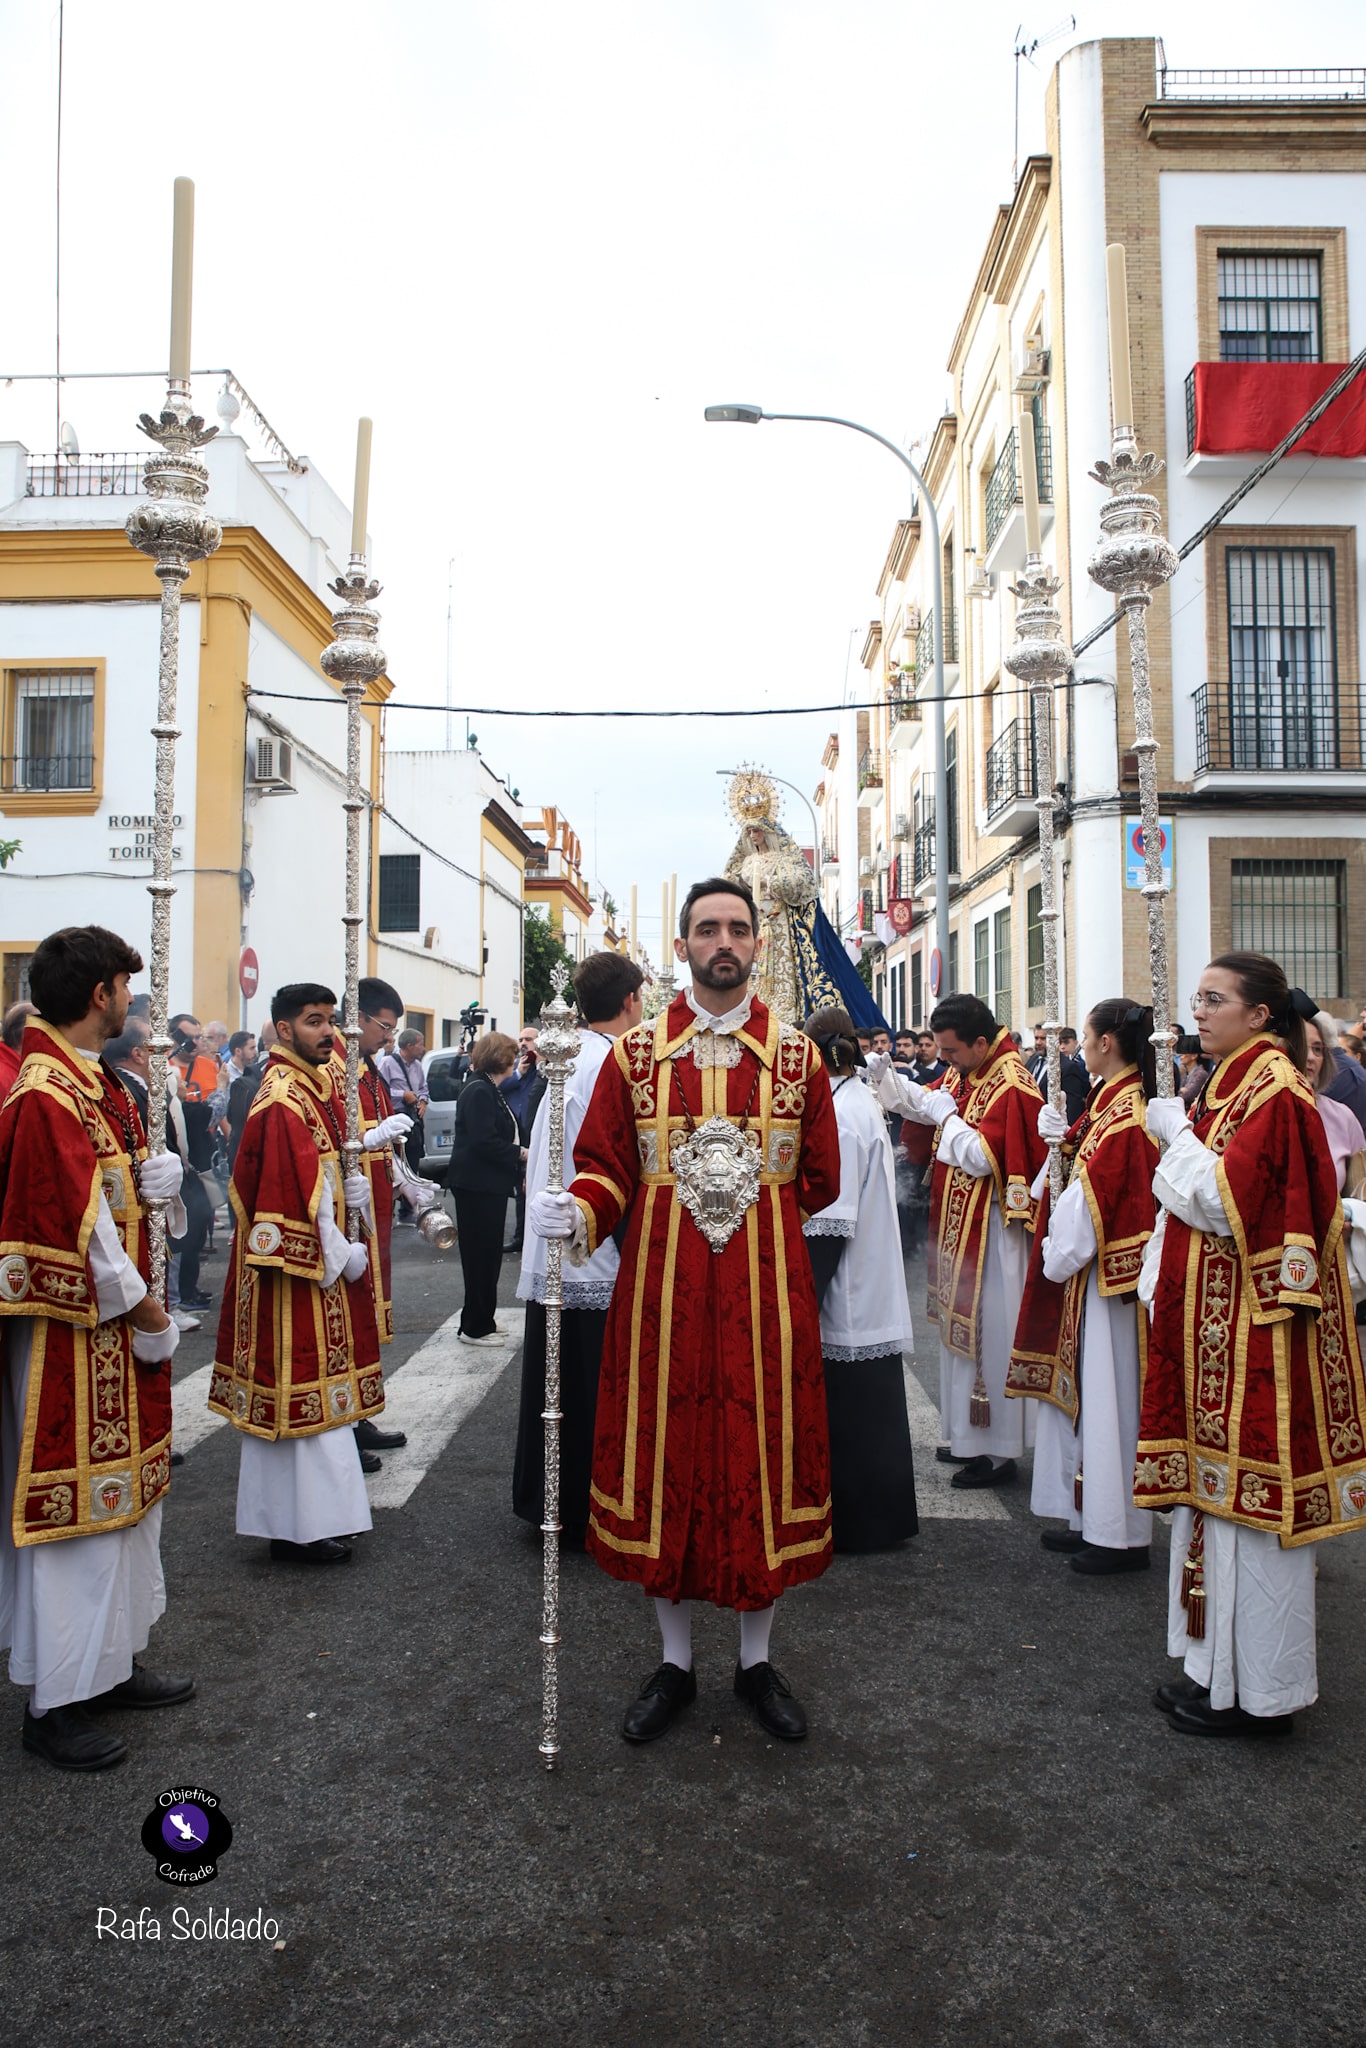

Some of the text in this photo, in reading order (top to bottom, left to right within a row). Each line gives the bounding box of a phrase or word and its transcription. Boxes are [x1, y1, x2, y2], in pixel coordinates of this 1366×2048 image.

[108, 815, 182, 827] ROMEO
[135, 833, 157, 845] DE
[109, 846, 182, 858] TORRS
